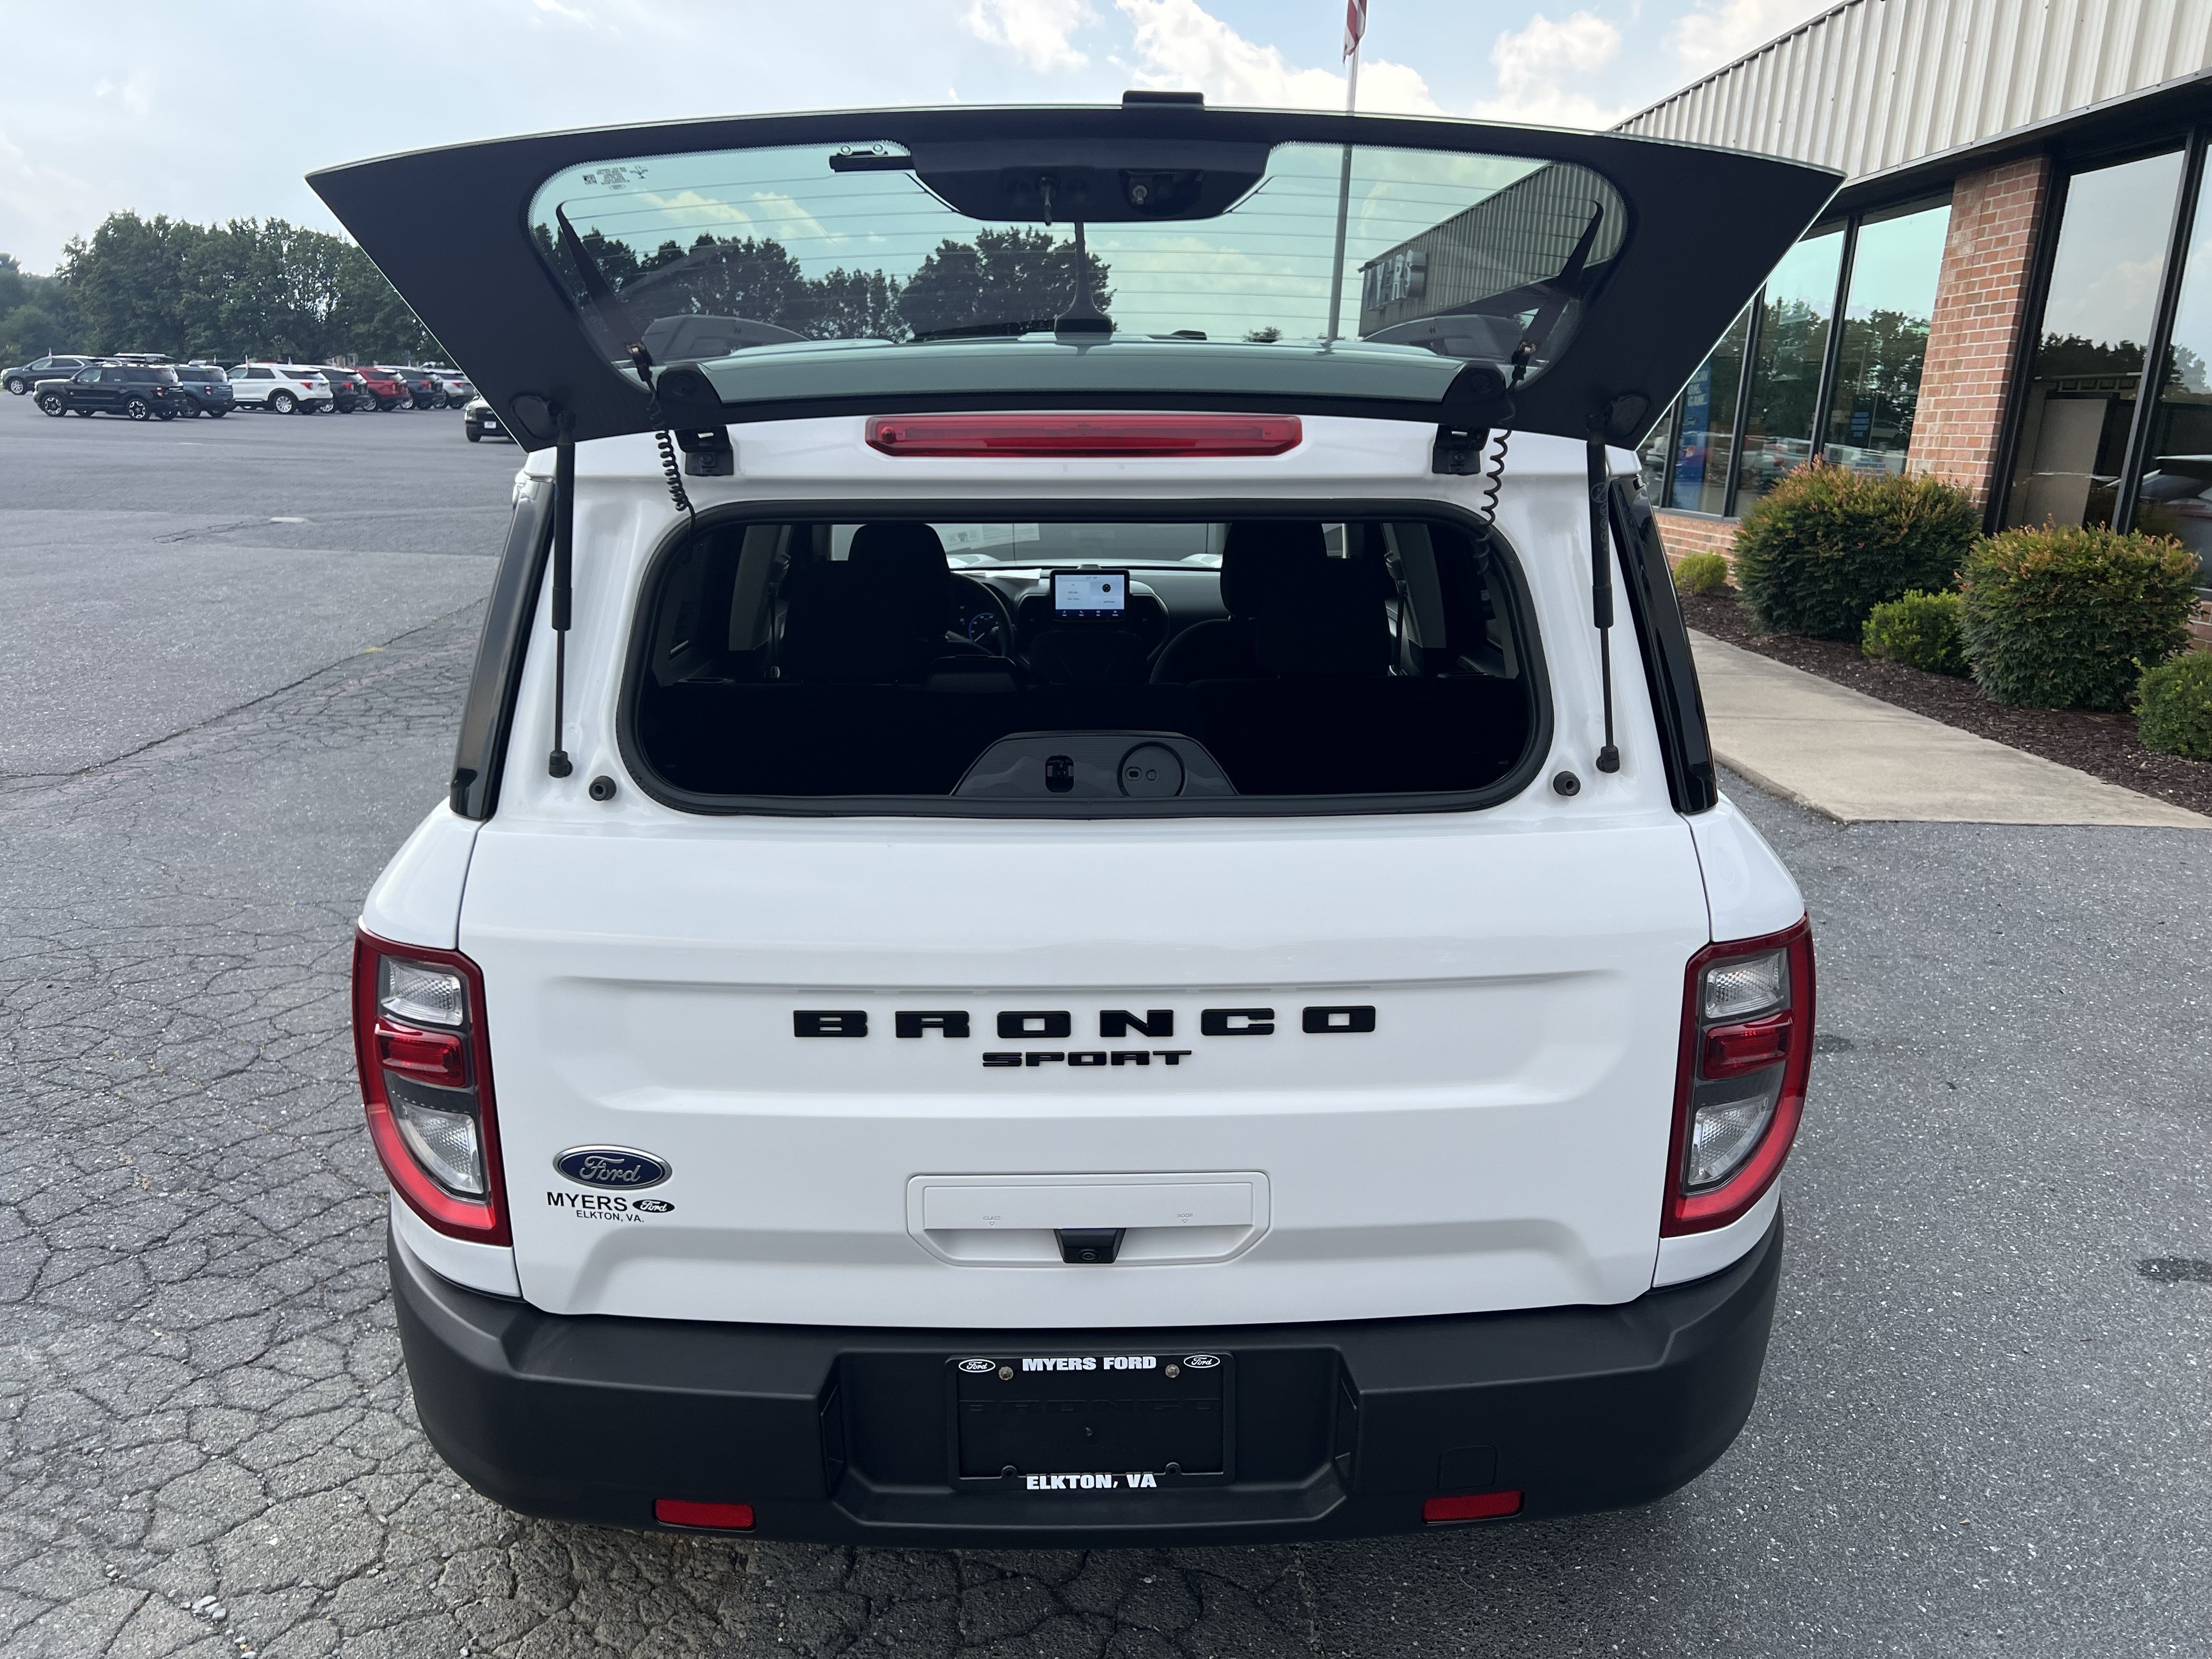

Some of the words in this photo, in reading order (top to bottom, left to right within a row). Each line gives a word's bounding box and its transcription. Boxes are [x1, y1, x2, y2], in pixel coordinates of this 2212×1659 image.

[793, 1005, 1376, 1038] BRONCO
[983, 1050, 1192, 1067] SPORT
[579, 1155, 641, 1182] Ford
[546, 1192, 628, 1212] MYERS
[639, 1200, 668, 1211] Ford
[576, 1210, 624, 1223] ELKTON,
[625, 1214, 645, 1223] VA.
[966, 1361, 988, 1370] Ford
[1022, 1357, 1097, 1372] MYERS
[1103, 1356, 1157, 1370] FORD
[1191, 1357, 1213, 1365] Ford
[1026, 1473, 1119, 1490] ELKTON,
[1126, 1473, 1157, 1488] VA
